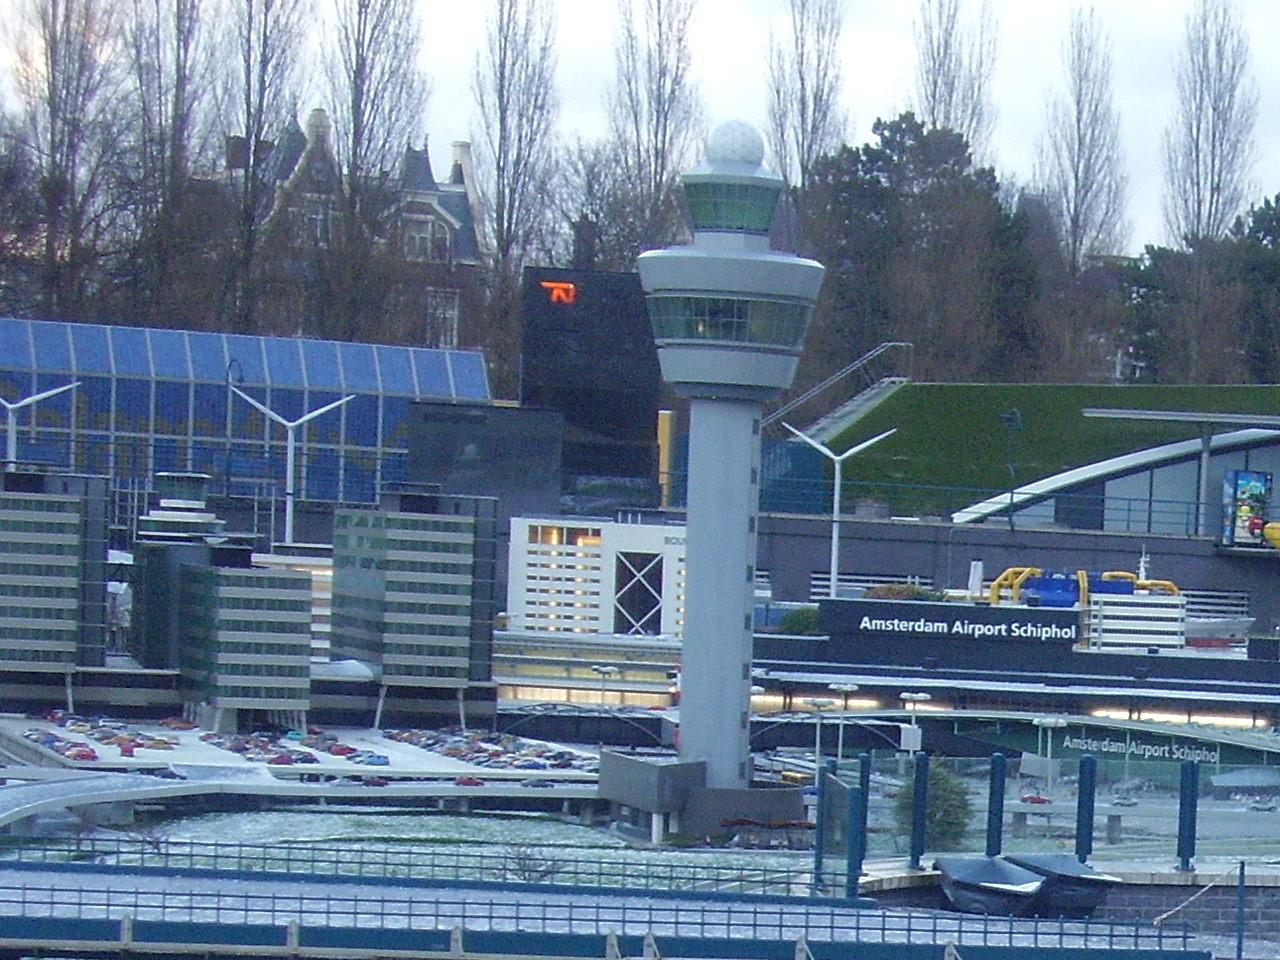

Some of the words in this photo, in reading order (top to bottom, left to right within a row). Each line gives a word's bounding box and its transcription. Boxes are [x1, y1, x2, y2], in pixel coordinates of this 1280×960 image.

[859, 616, 948, 633] Amsterdam
[951, 620, 1008, 638] Airport
[1010, 622, 1077, 640] Schiphol
[1063, 735, 1125, 753] Amstedam
[1129, 741, 1170, 759] Airport
[1172, 744, 1219, 763] Schipho
